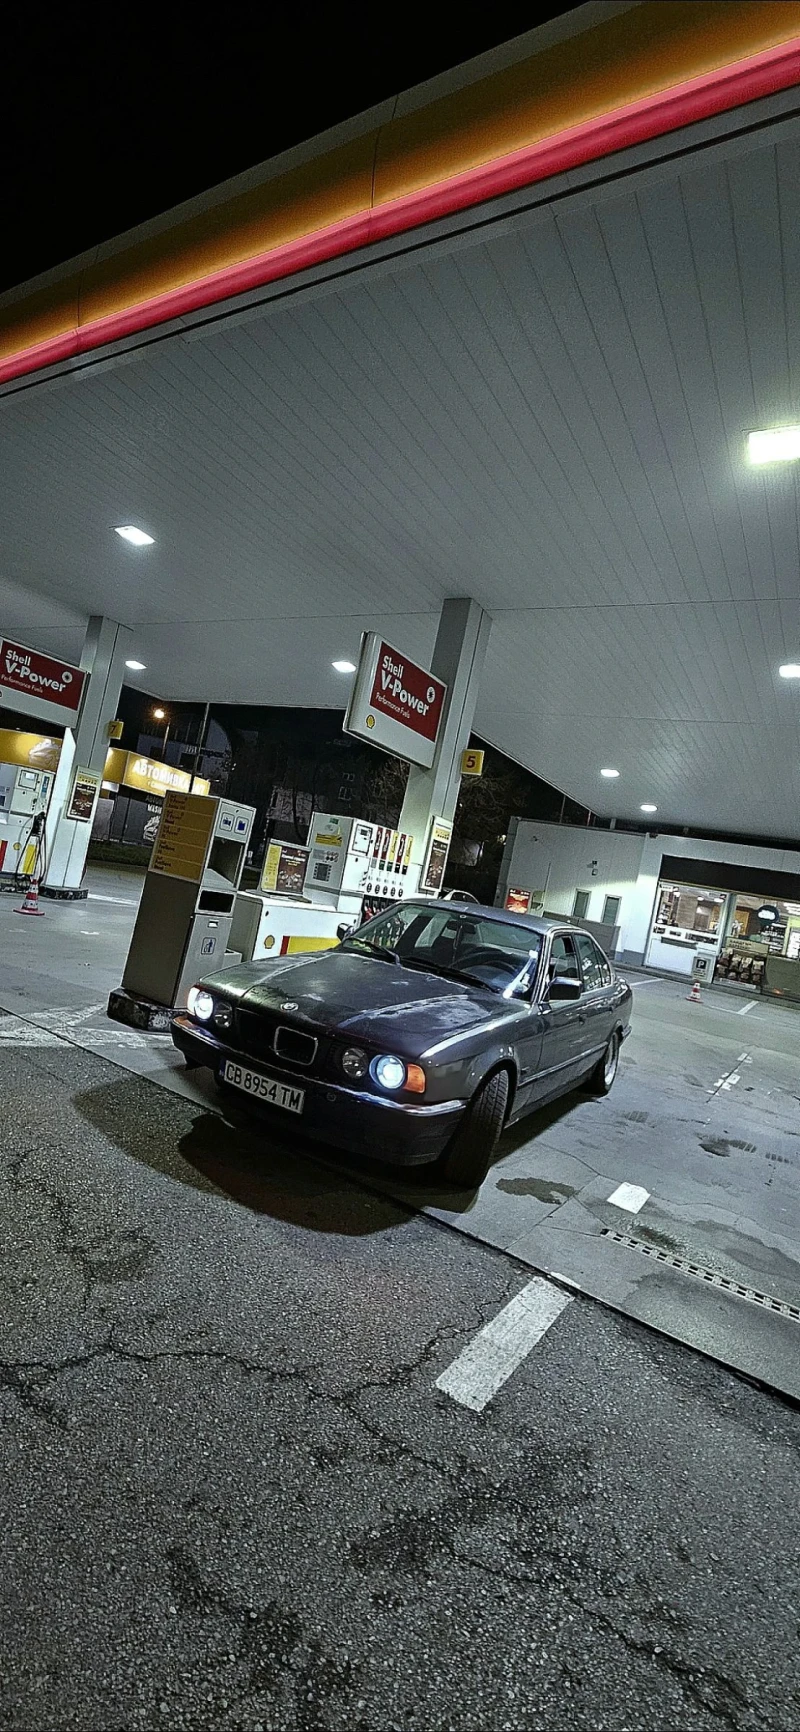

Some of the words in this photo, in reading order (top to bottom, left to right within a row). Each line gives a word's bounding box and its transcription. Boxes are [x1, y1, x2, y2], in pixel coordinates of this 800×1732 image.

[6, 650, 31, 672] Shell
[382, 655, 404, 678] Shell
[6, 659, 66, 692] V-Power
[381, 669, 429, 716] V-Power
[111, 725, 117, 733] 7
[466, 755, 476, 768] 5
[227, 1064, 242, 1084] CB
[244, 1072, 278, 1101] 8954
[281, 1086, 301, 1111] TM
